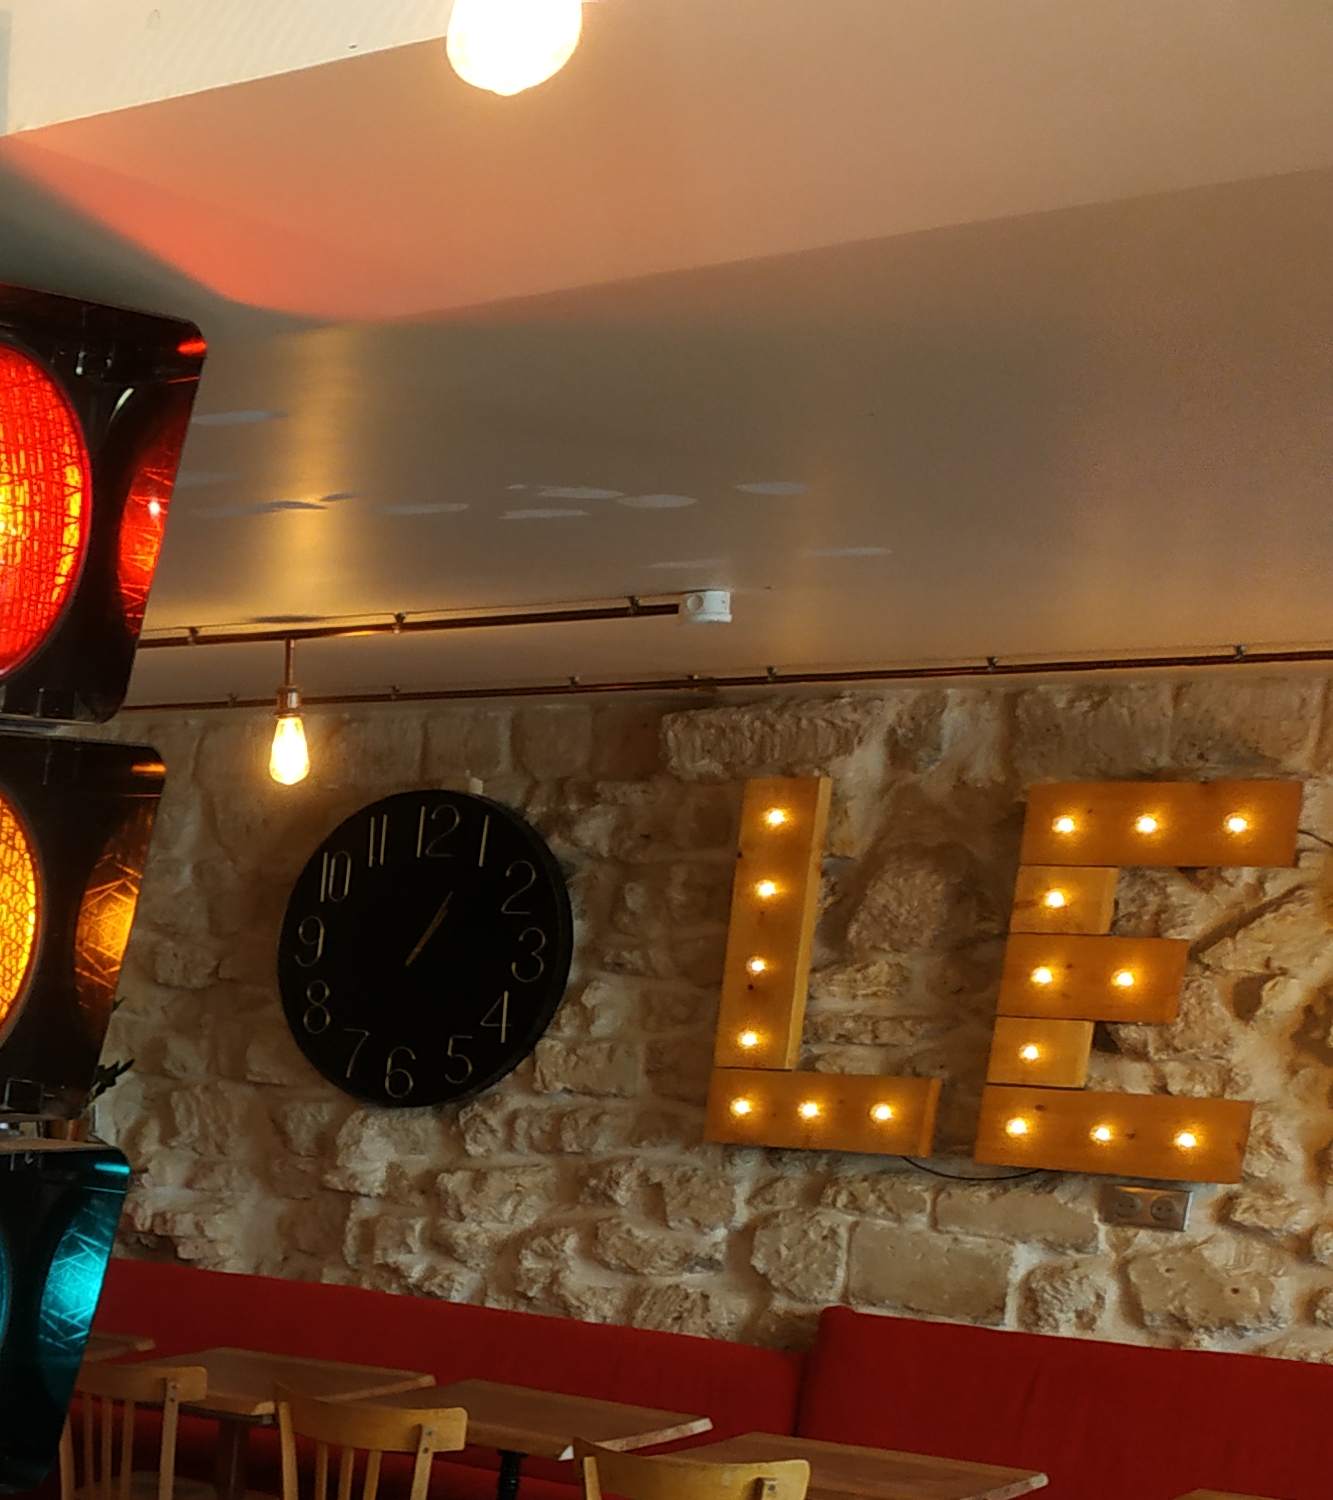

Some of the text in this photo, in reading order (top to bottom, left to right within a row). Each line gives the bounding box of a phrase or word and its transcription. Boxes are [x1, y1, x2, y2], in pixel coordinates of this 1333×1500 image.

[368, 814, 388, 868] 11
[416, 804, 461, 859] 12
[478, 814, 490, 868] 1
[320, 850, 352, 903] 10
[500, 860, 536, 915] 2
[295, 916, 325, 968] 9
[510, 928, 547, 982] 3
[303, 980, 332, 1034] 8
[703, 777, 1303, 1184] LE
[480, 990, 513, 1044] 4
[344, 1028, 370, 1080] 7
[384, 1046, 417, 1099] 6
[444, 1035, 474, 1085] 5
